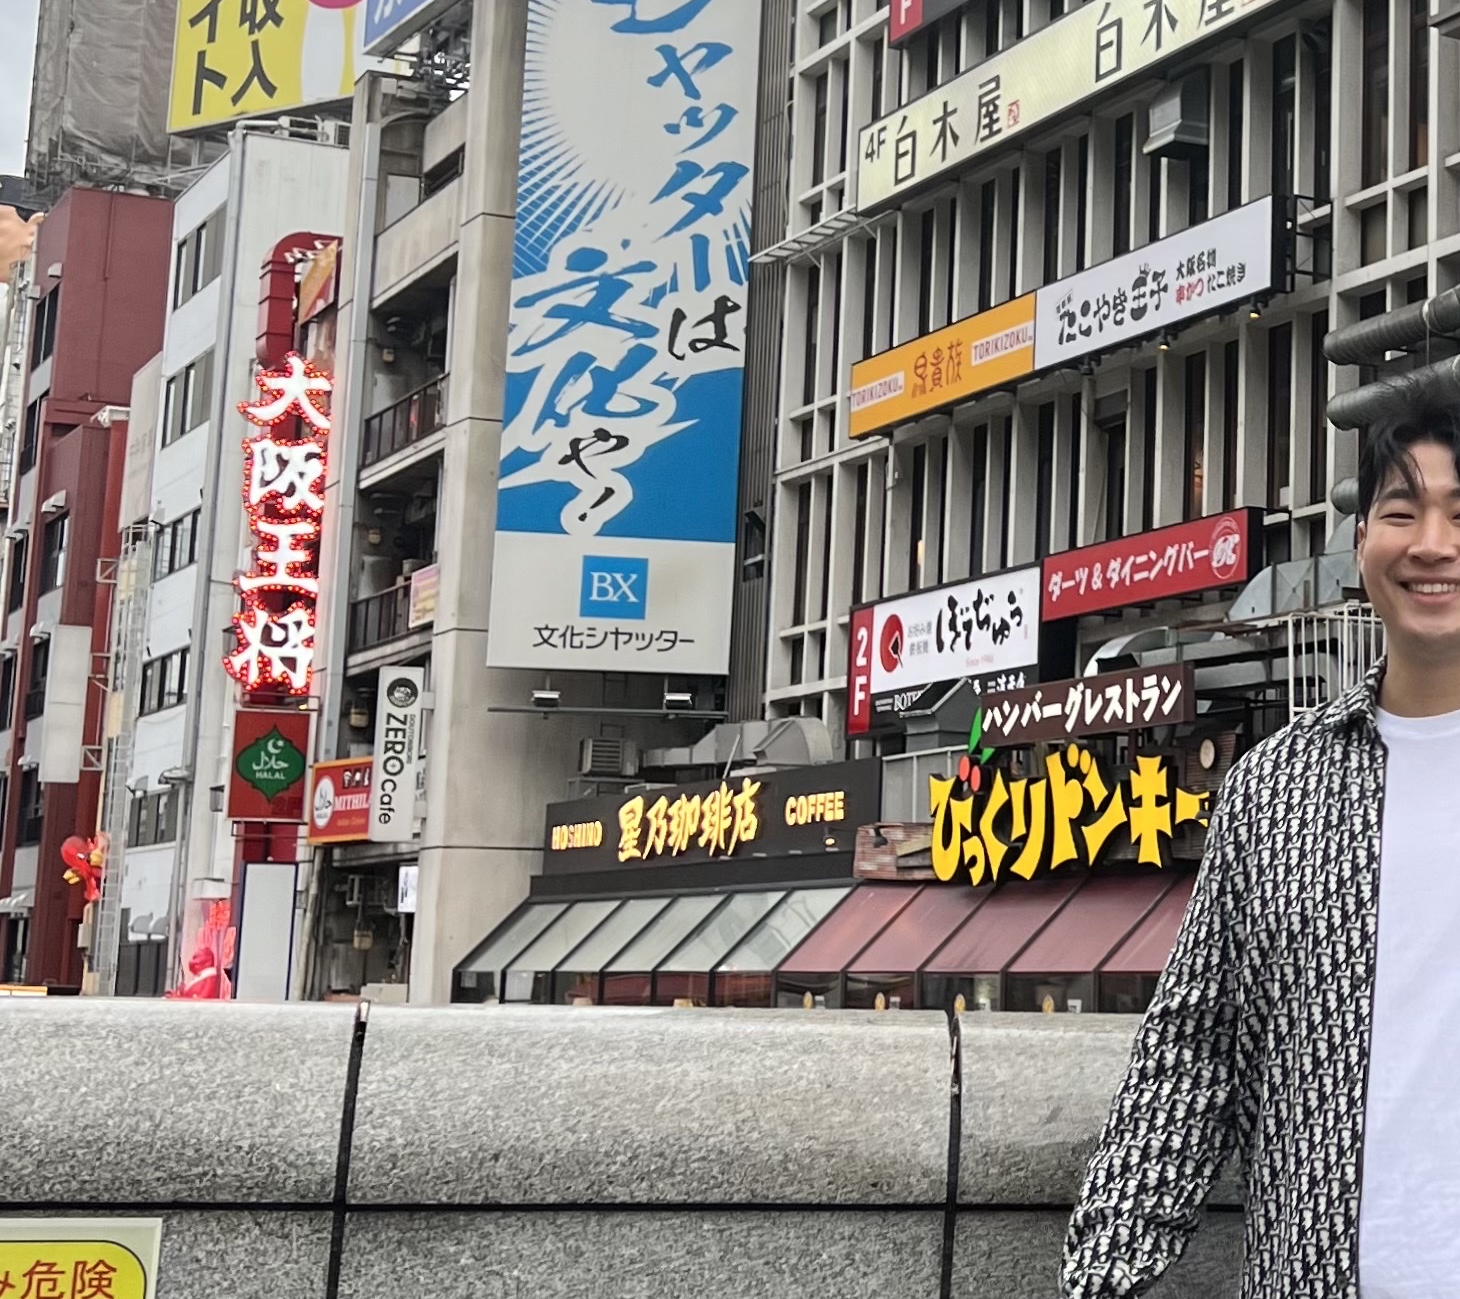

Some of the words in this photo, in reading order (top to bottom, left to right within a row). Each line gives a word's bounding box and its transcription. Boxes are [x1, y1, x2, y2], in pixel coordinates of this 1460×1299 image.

[864, 126, 888, 163] 4F
[894, 73, 1002, 187] 白木屋
[1058, 263, 1169, 345] たこやき王子
[911, 338, 963, 399] 鳥貴族
[974, 325, 1028, 362] TORIKIZOKU
[222, 350, 335, 695] 大阪王将
[589, 571, 639, 603] BX
[1048, 567, 1089, 602] ダーツ
[1106, 541, 1210, 589] ダイニングバー
[854, 626, 868, 716] 2F
[982, 674, 1182, 737] ハンバーグレストラン
[255, 771, 286, 780] HALAL
[382, 712, 408, 777] ZERO
[552, 820, 603, 850] HOSHINO
[618, 777, 762, 862] 星乃珈琲店
[785, 791, 845, 826] COFFEE
[928, 742, 1211, 887] びっくりドンキー
